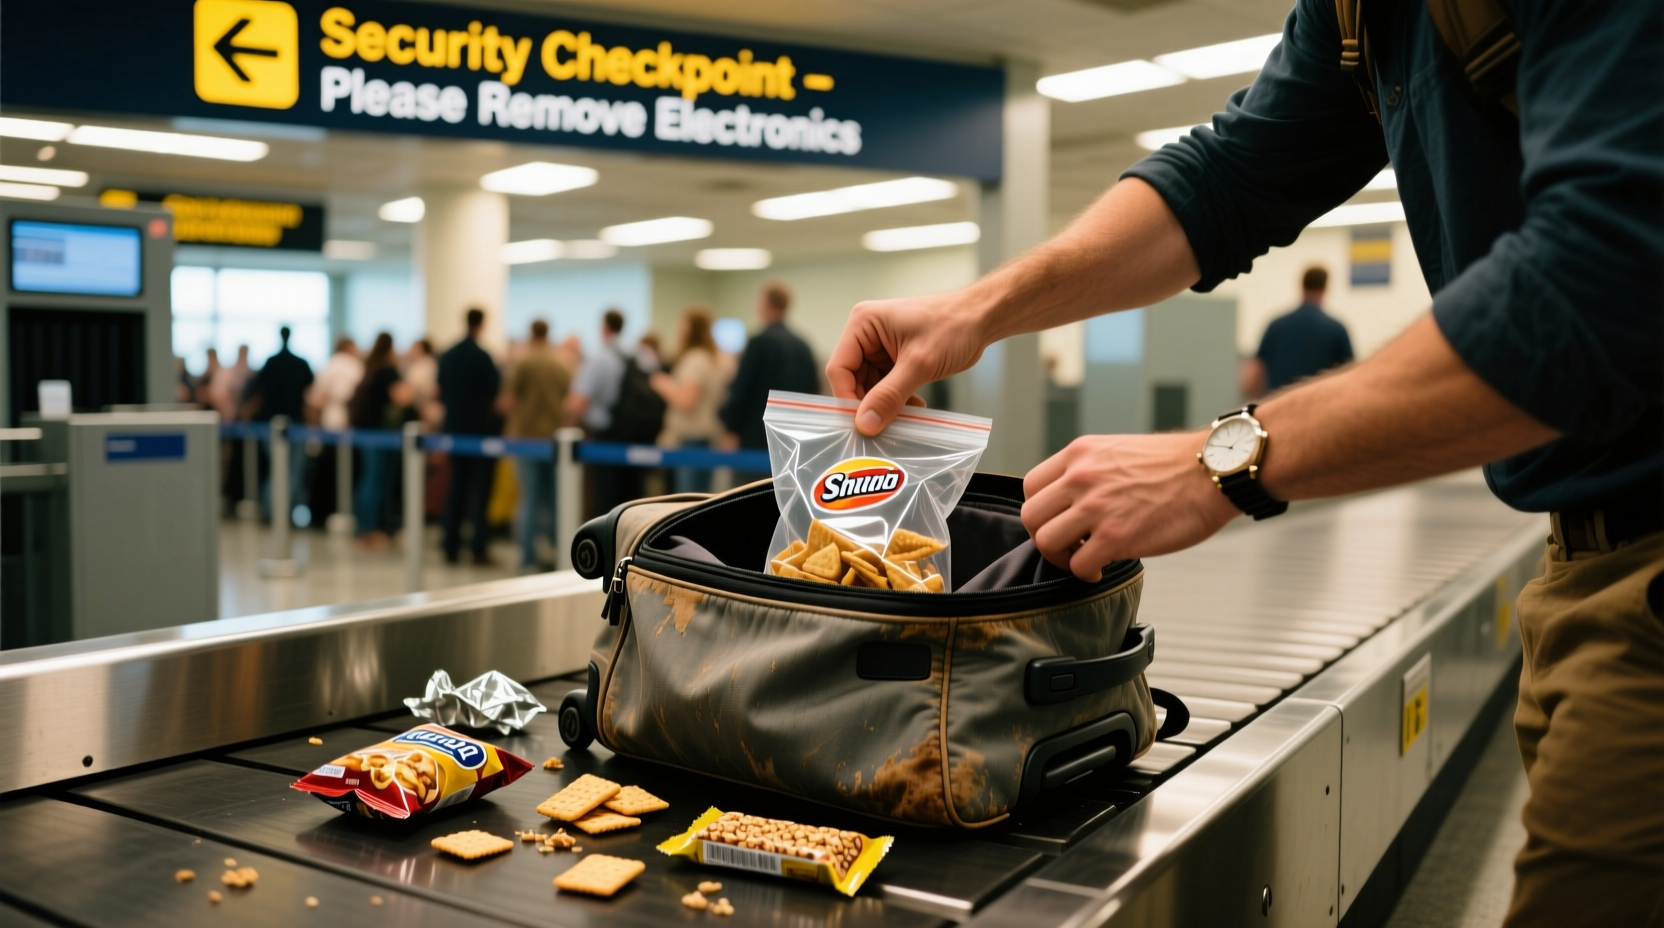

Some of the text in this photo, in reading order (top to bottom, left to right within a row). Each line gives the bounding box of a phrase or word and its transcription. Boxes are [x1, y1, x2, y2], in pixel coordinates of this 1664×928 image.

[320, 7, 533, 86] Security
[540, 29, 797, 101] Checkpoint
[320, 66, 863, 156] Please Remove Electronics
